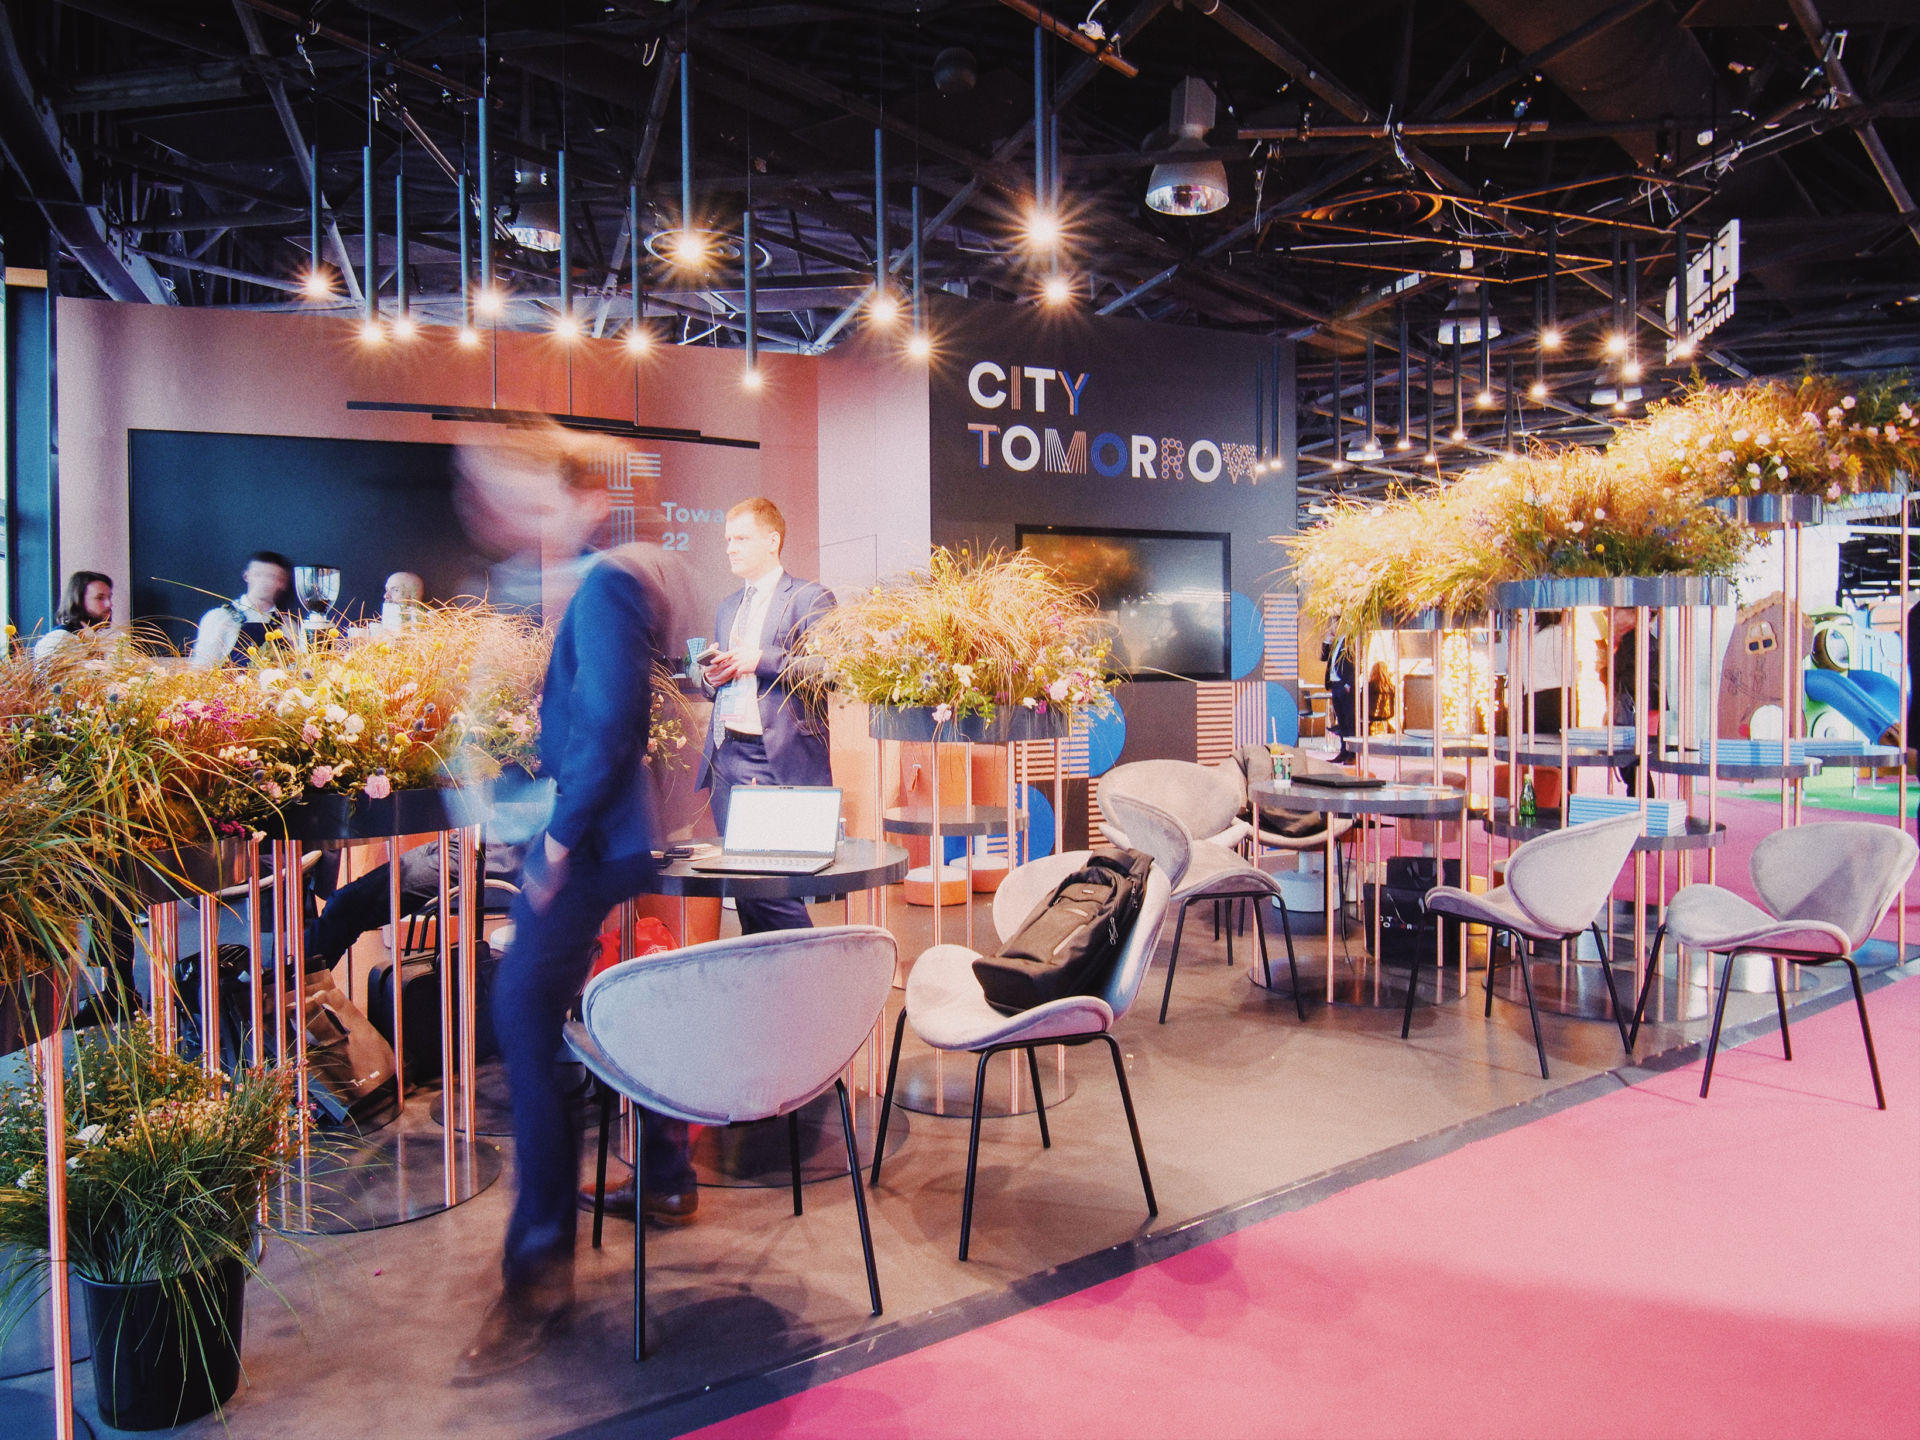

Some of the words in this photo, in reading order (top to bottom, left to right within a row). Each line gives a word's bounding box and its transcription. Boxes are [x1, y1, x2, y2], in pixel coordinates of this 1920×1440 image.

[968, 361, 1090, 415] CITY
[968, 423, 1267, 485] TOMORROW
[662, 532, 690, 551] 22
